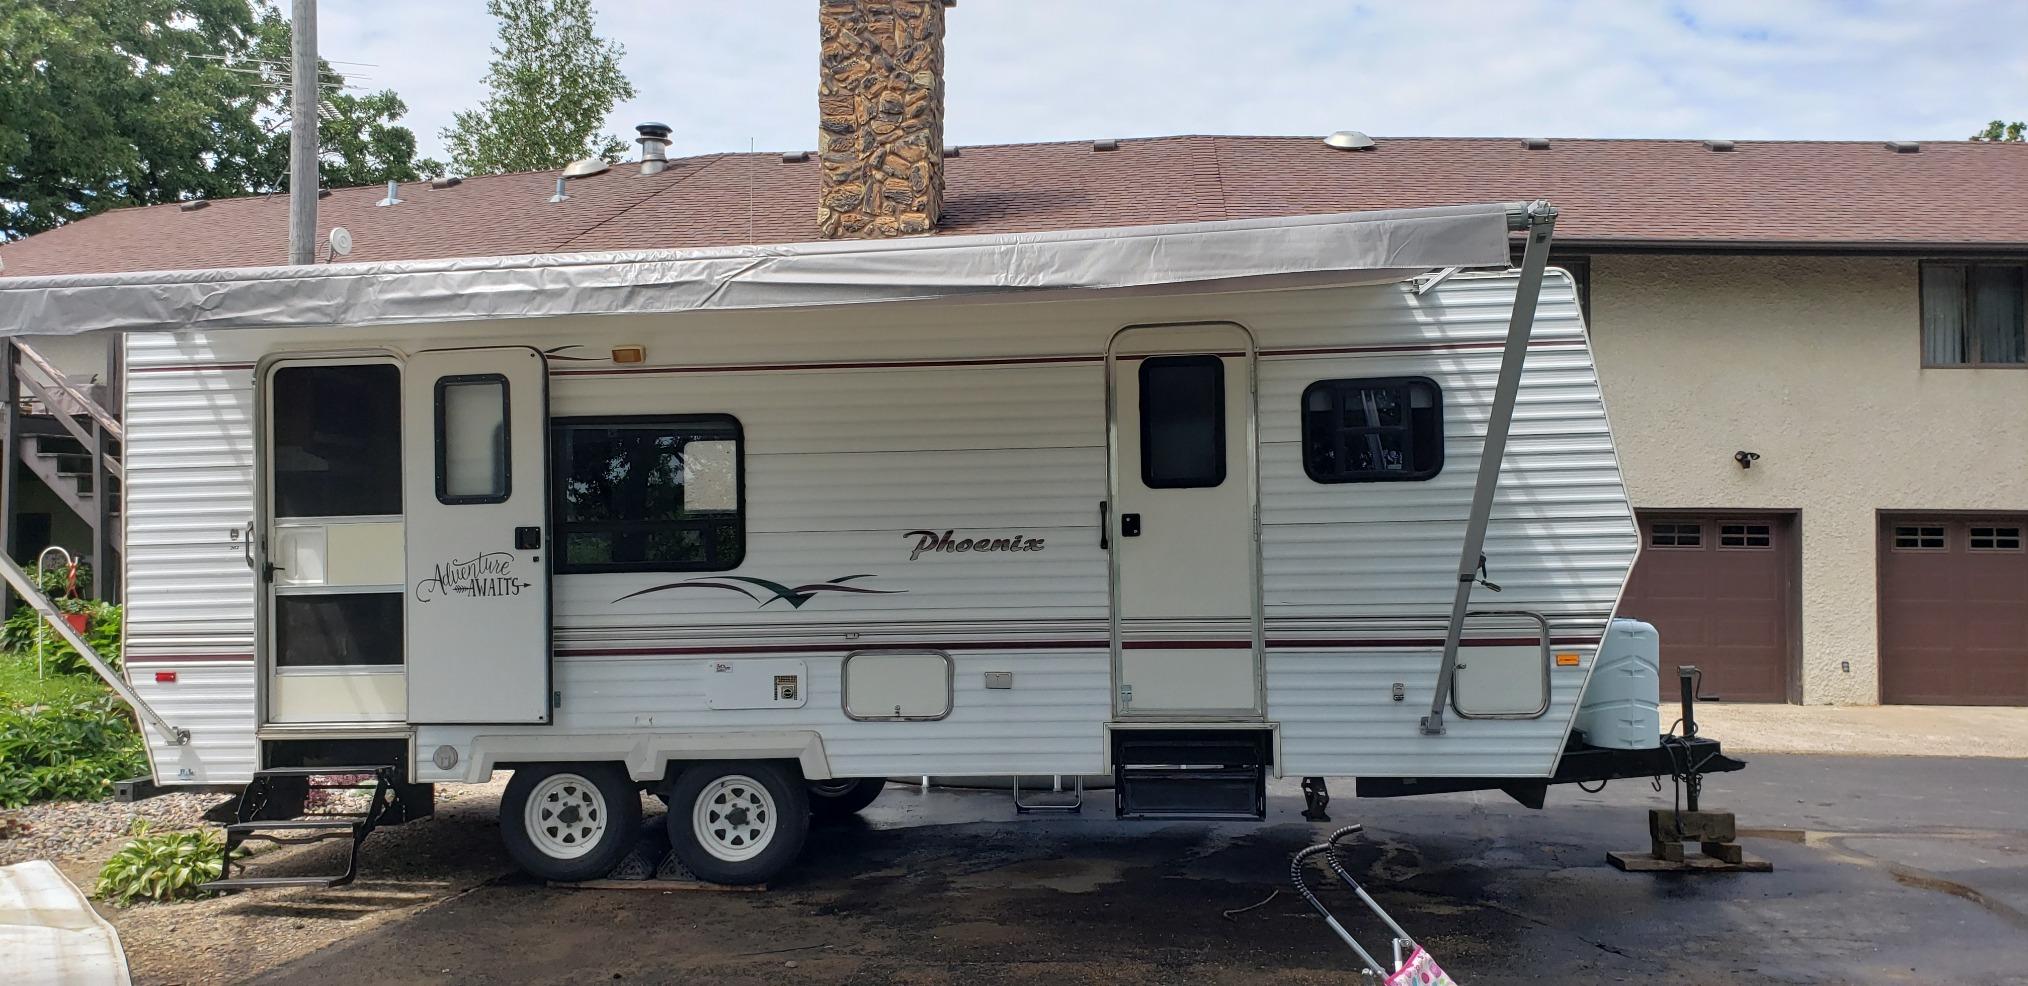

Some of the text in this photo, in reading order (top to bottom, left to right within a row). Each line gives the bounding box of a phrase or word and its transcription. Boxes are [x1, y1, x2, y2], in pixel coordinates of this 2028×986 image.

[903, 529, 1045, 561] Phoenix
[416, 552, 514, 602] Adventure
[468, 577, 520, 597] AWAITS
